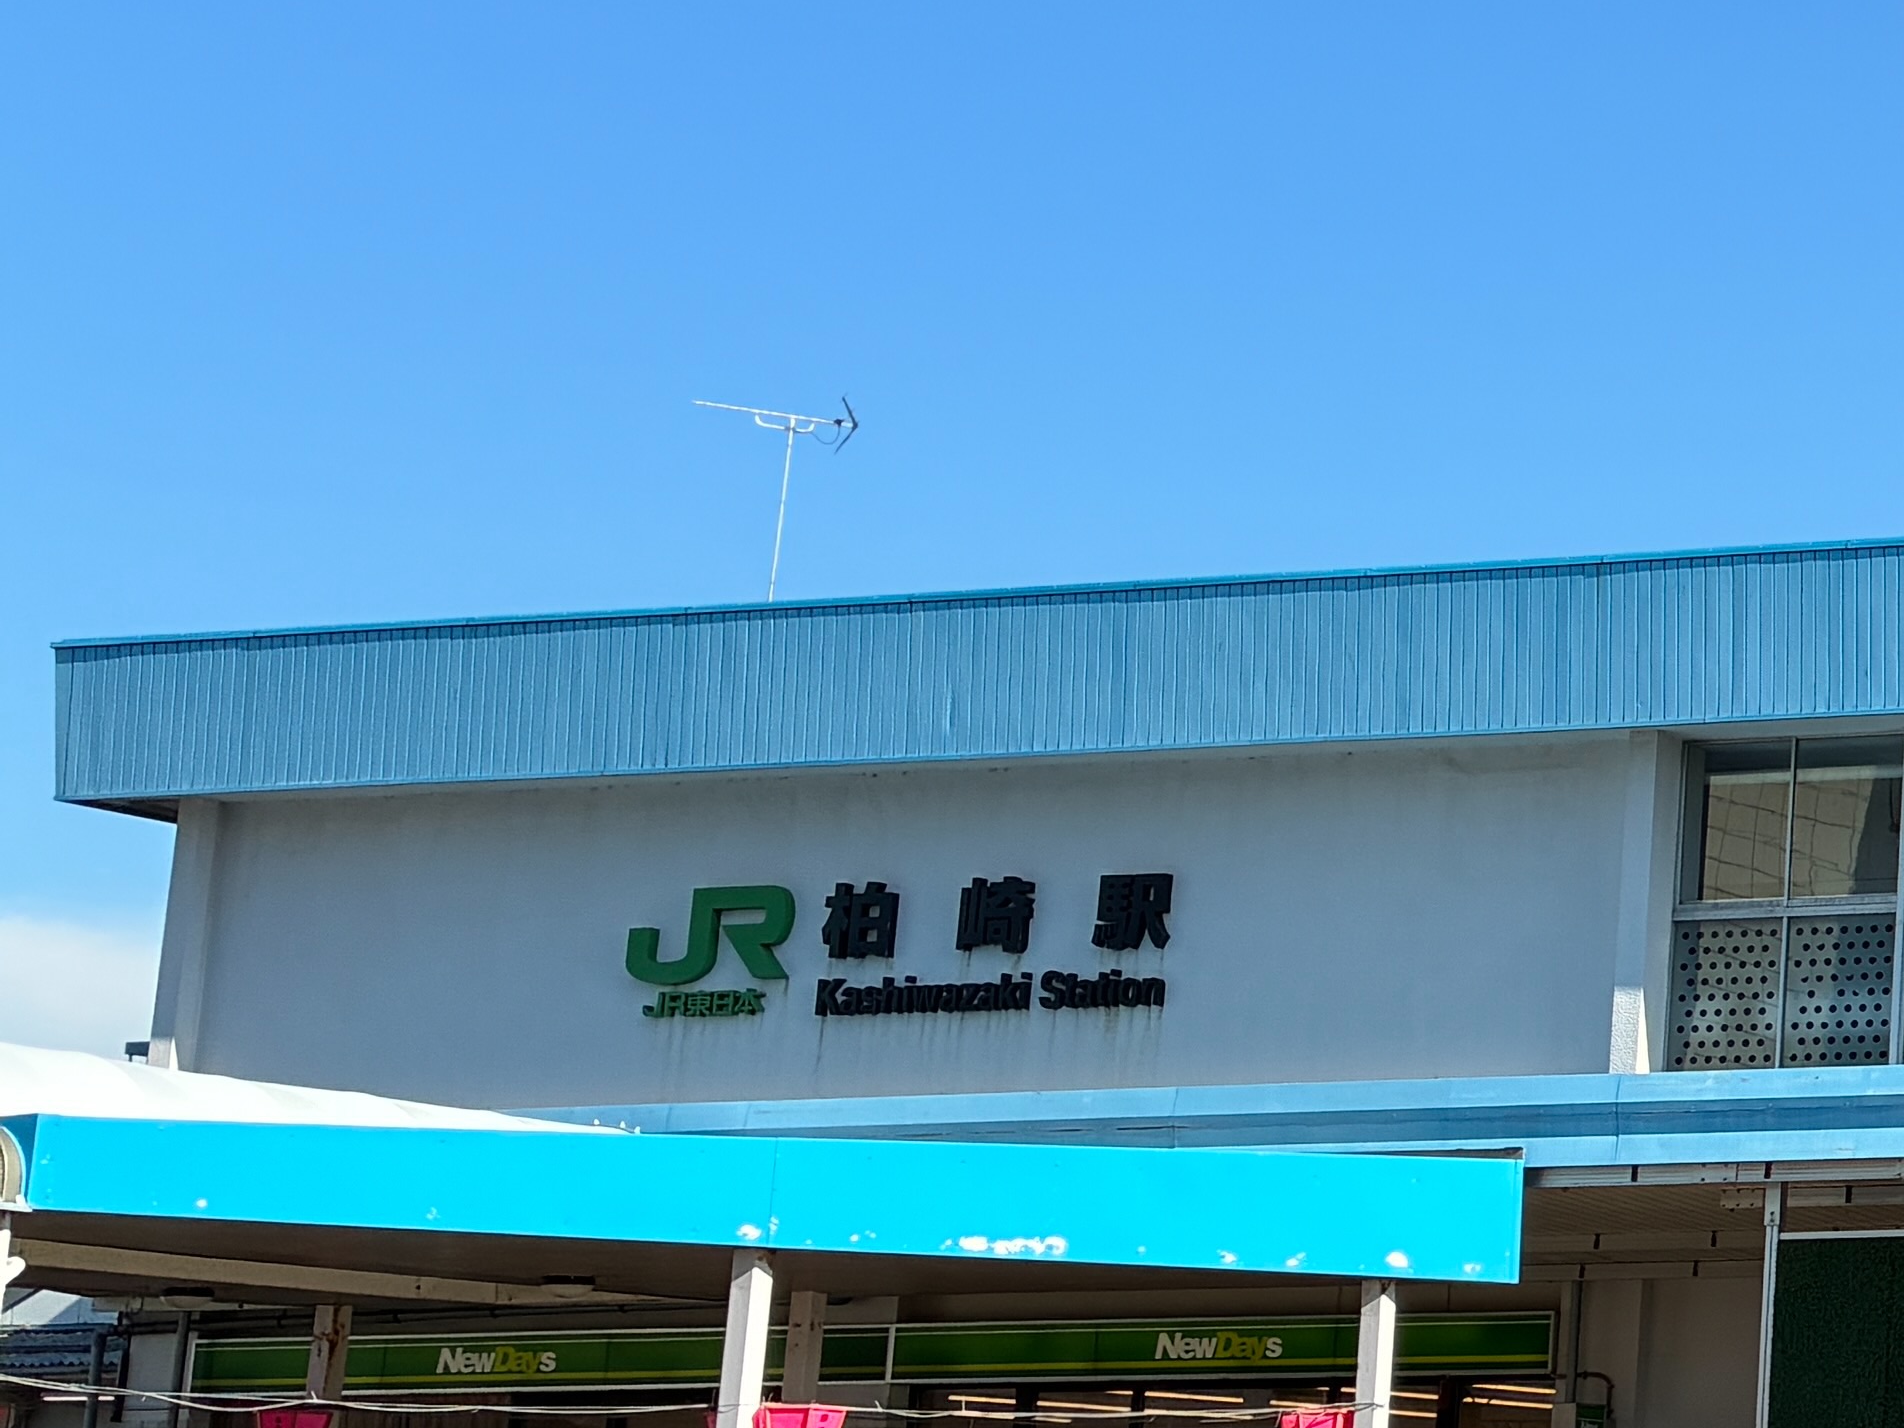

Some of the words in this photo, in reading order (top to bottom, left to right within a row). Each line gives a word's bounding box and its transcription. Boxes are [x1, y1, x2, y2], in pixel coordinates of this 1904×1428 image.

[625, 884, 796, 985] JR
[821, 872, 1174, 959] 柏崎駅
[642, 987, 766, 1018] JR東日本
[814, 974, 1033, 1016] Kashiwazaki
[1038, 969, 1166, 1010] Station
[436, 1345, 557, 1374] NewDays
[1155, 1331, 1283, 1362] NewDays
